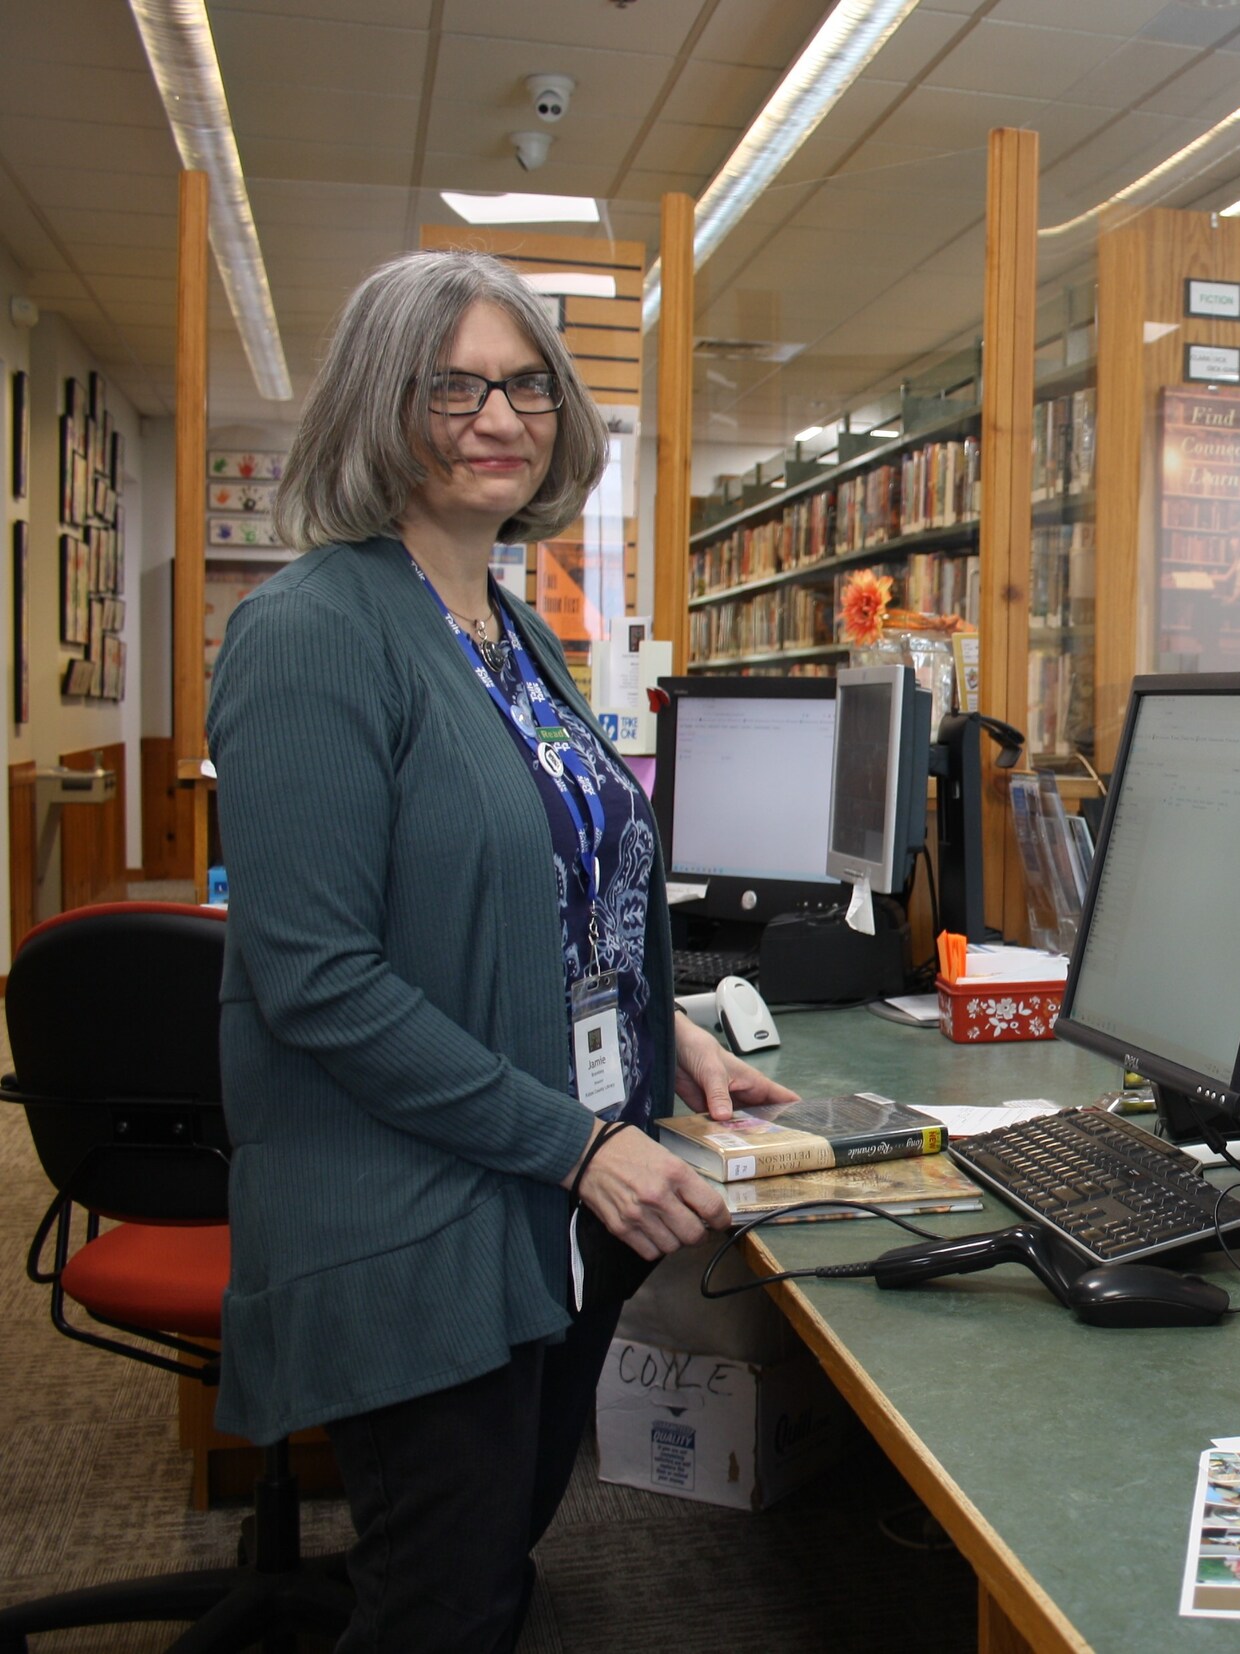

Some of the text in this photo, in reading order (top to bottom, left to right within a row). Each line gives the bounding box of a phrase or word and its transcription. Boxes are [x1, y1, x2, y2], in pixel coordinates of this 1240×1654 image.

[1200, 293, 1234, 305] FICTION
[1191, 406, 1236, 427] Find
[621, 715, 638, 728] TAKE
[541, 730, 564, 739] Read
[620, 726, 638, 740] ONE
[588, 1056, 606, 1071] Jamie
[928, 1131, 937, 1149] NEW
[847, 1145, 876, 1160] Grande
[876, 1142, 891, 1156] Rio
[757, 1150, 812, 1164] PETERSON
[618, 1345, 742, 1397] COYLE
[652, 1430, 693, 1447] QUALITY
